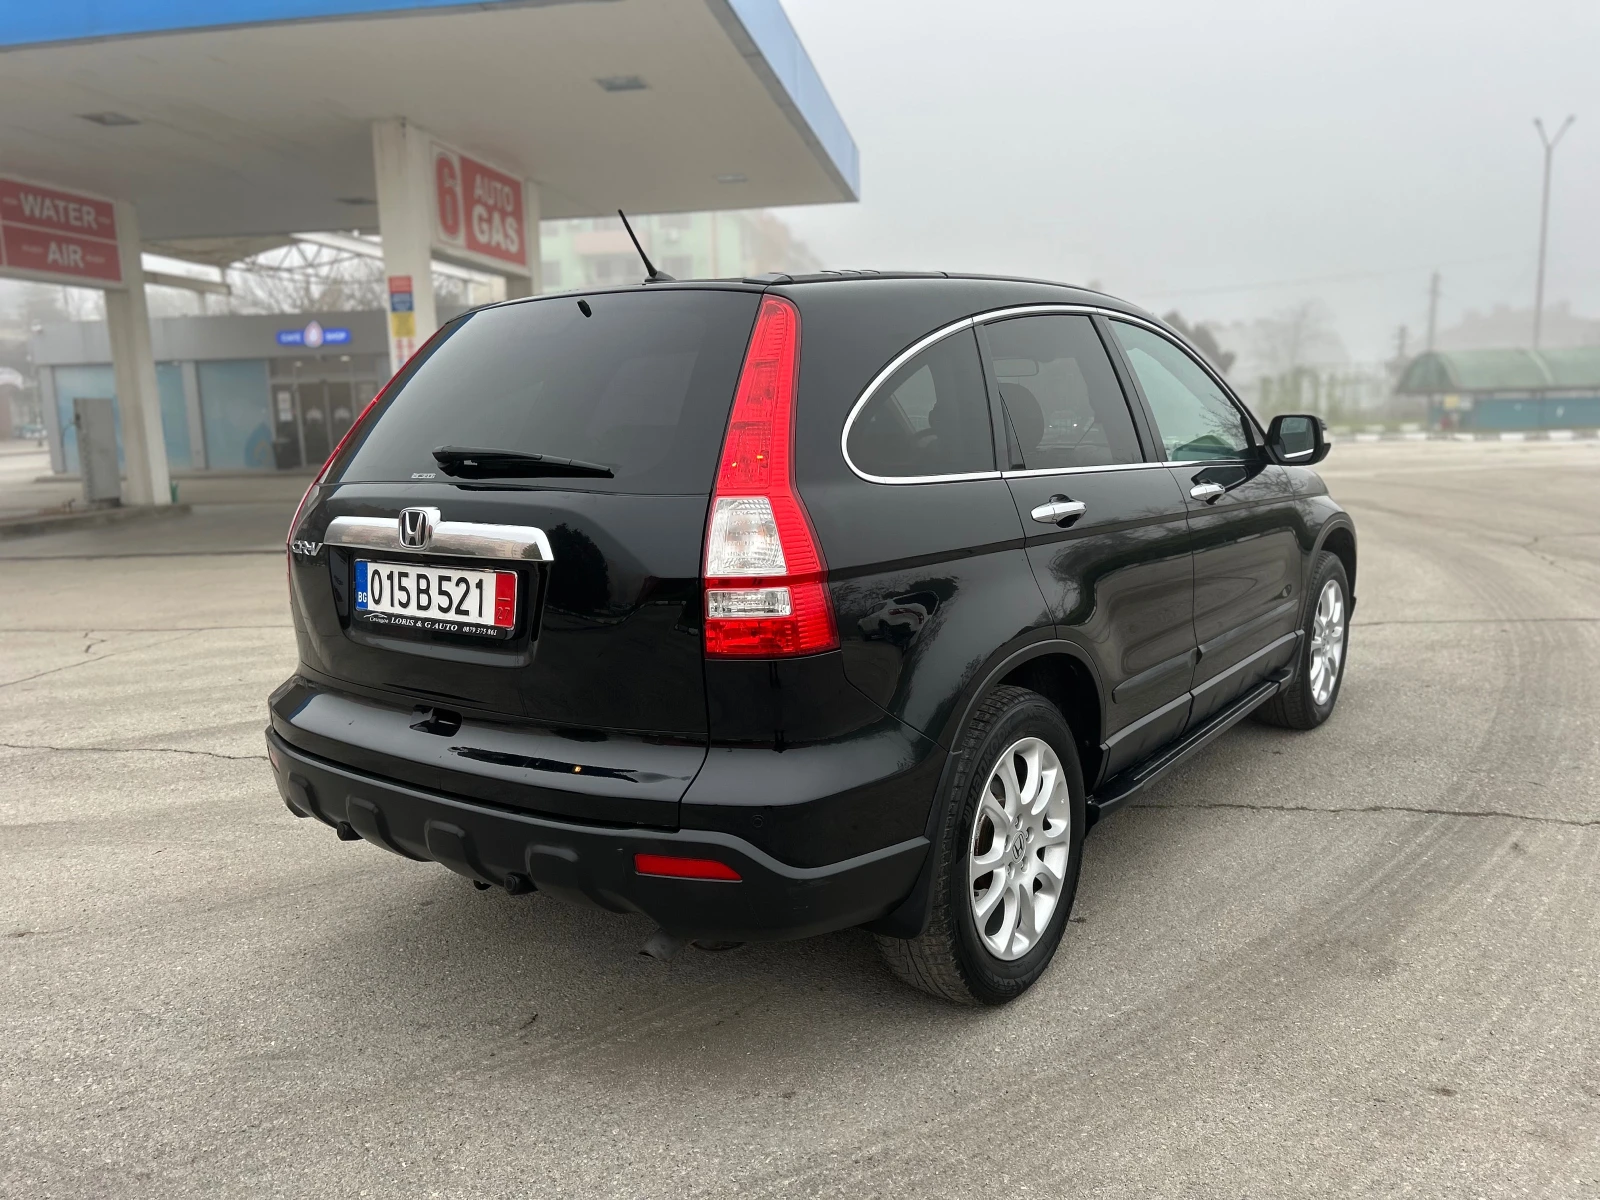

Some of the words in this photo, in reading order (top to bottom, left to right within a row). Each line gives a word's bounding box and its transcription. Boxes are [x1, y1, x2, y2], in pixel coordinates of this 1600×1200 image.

[19, 192, 98, 230] WATER
[435, 152, 460, 239] 6
[474, 173, 514, 213] AUTO
[471, 203, 519, 254] GAS
[47, 240, 84, 269] AIR
[358, 591, 368, 603] BG
[390, 616, 415, 627] LORIS
[415, 620, 423, 628] &
[424, 621, 432, 629] G
[432, 622, 458, 632] AUTO
